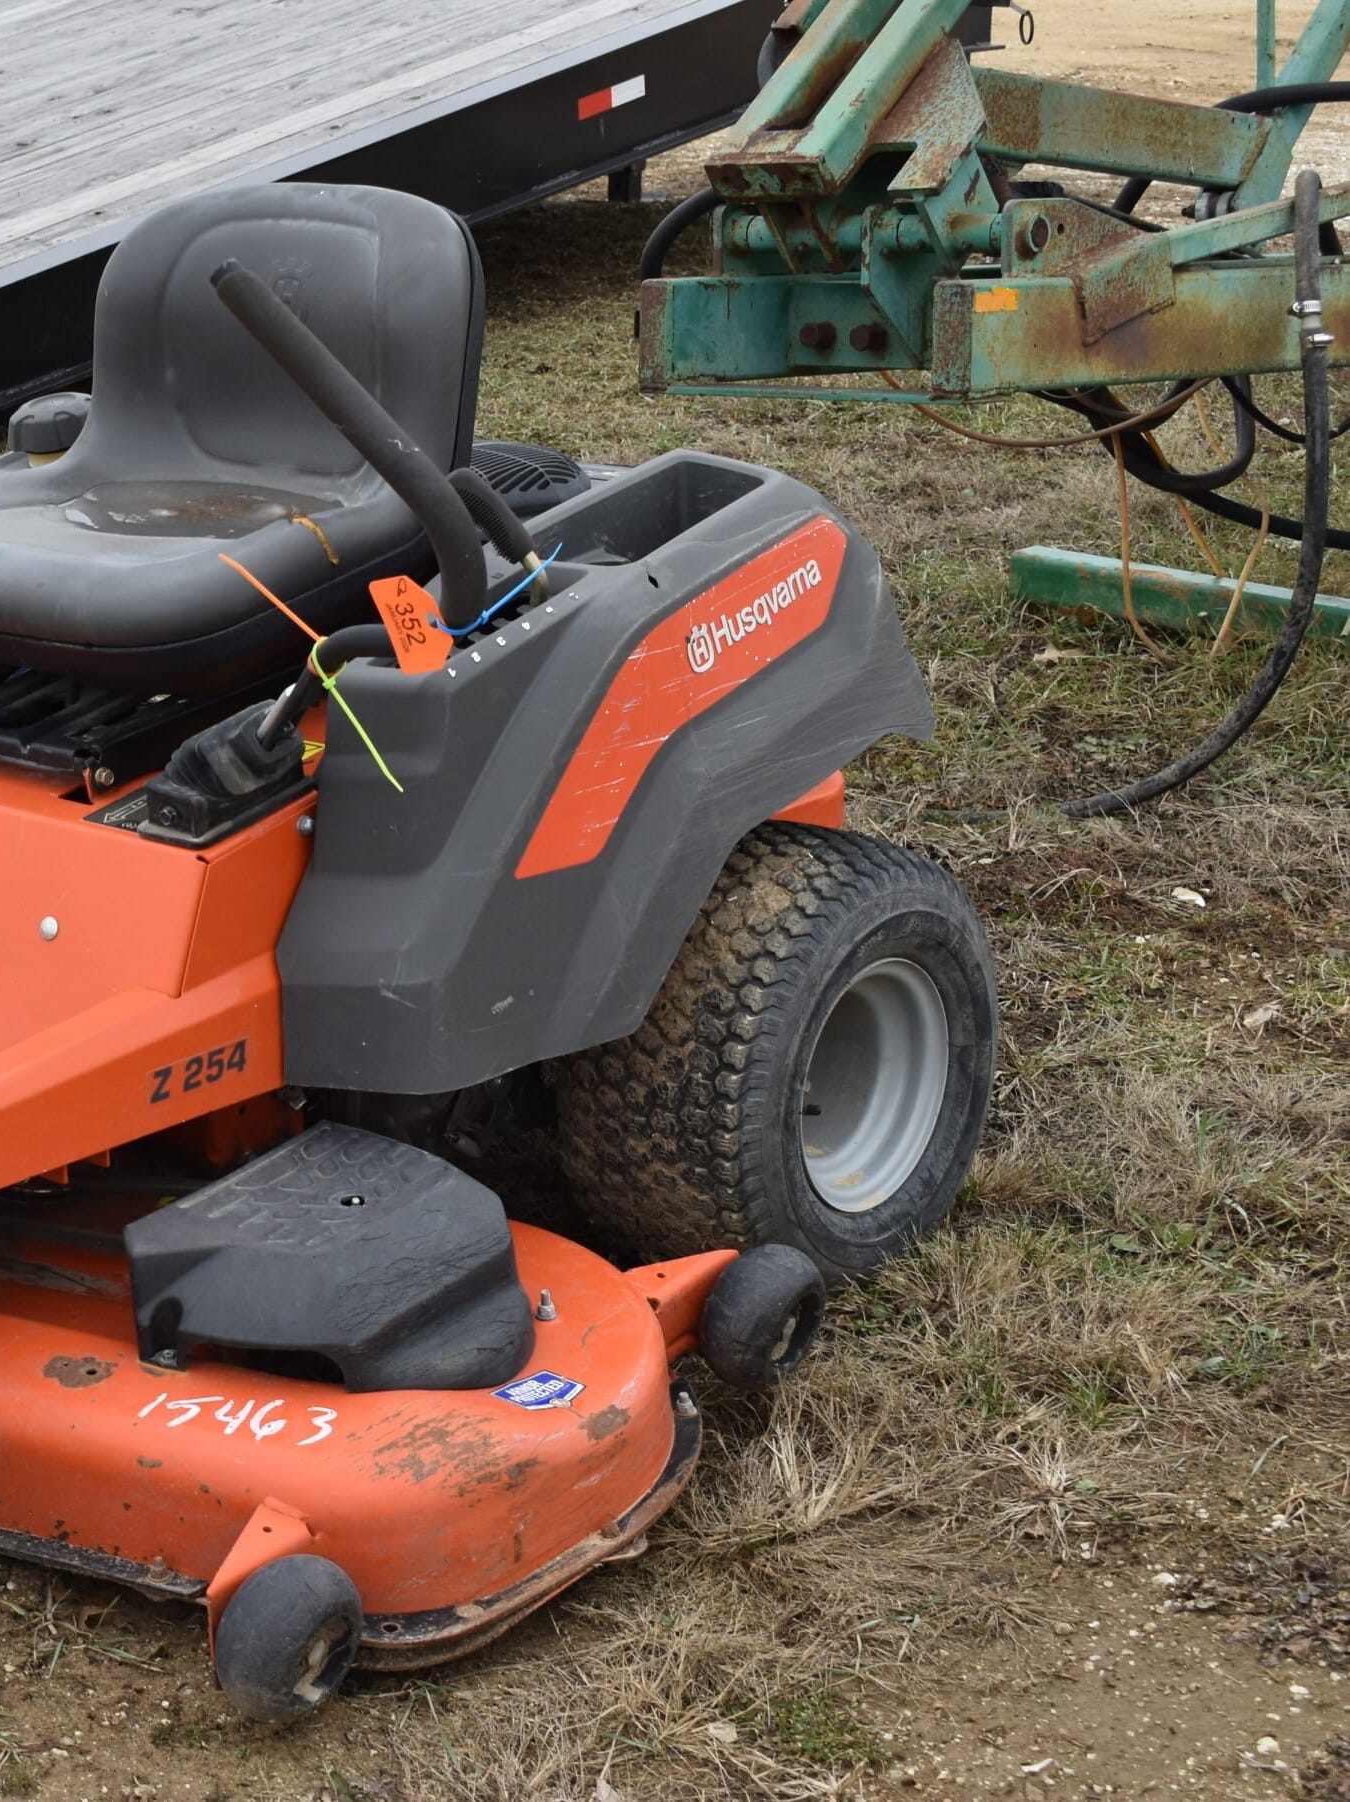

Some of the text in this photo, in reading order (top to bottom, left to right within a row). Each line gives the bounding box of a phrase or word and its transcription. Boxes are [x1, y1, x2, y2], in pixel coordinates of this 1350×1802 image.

[395, 602, 426, 647] 352
[710, 559, 822, 654] Husqvarna
[150, 1039, 247, 1104] Z 254
[137, 1392, 338, 1446] 15463
